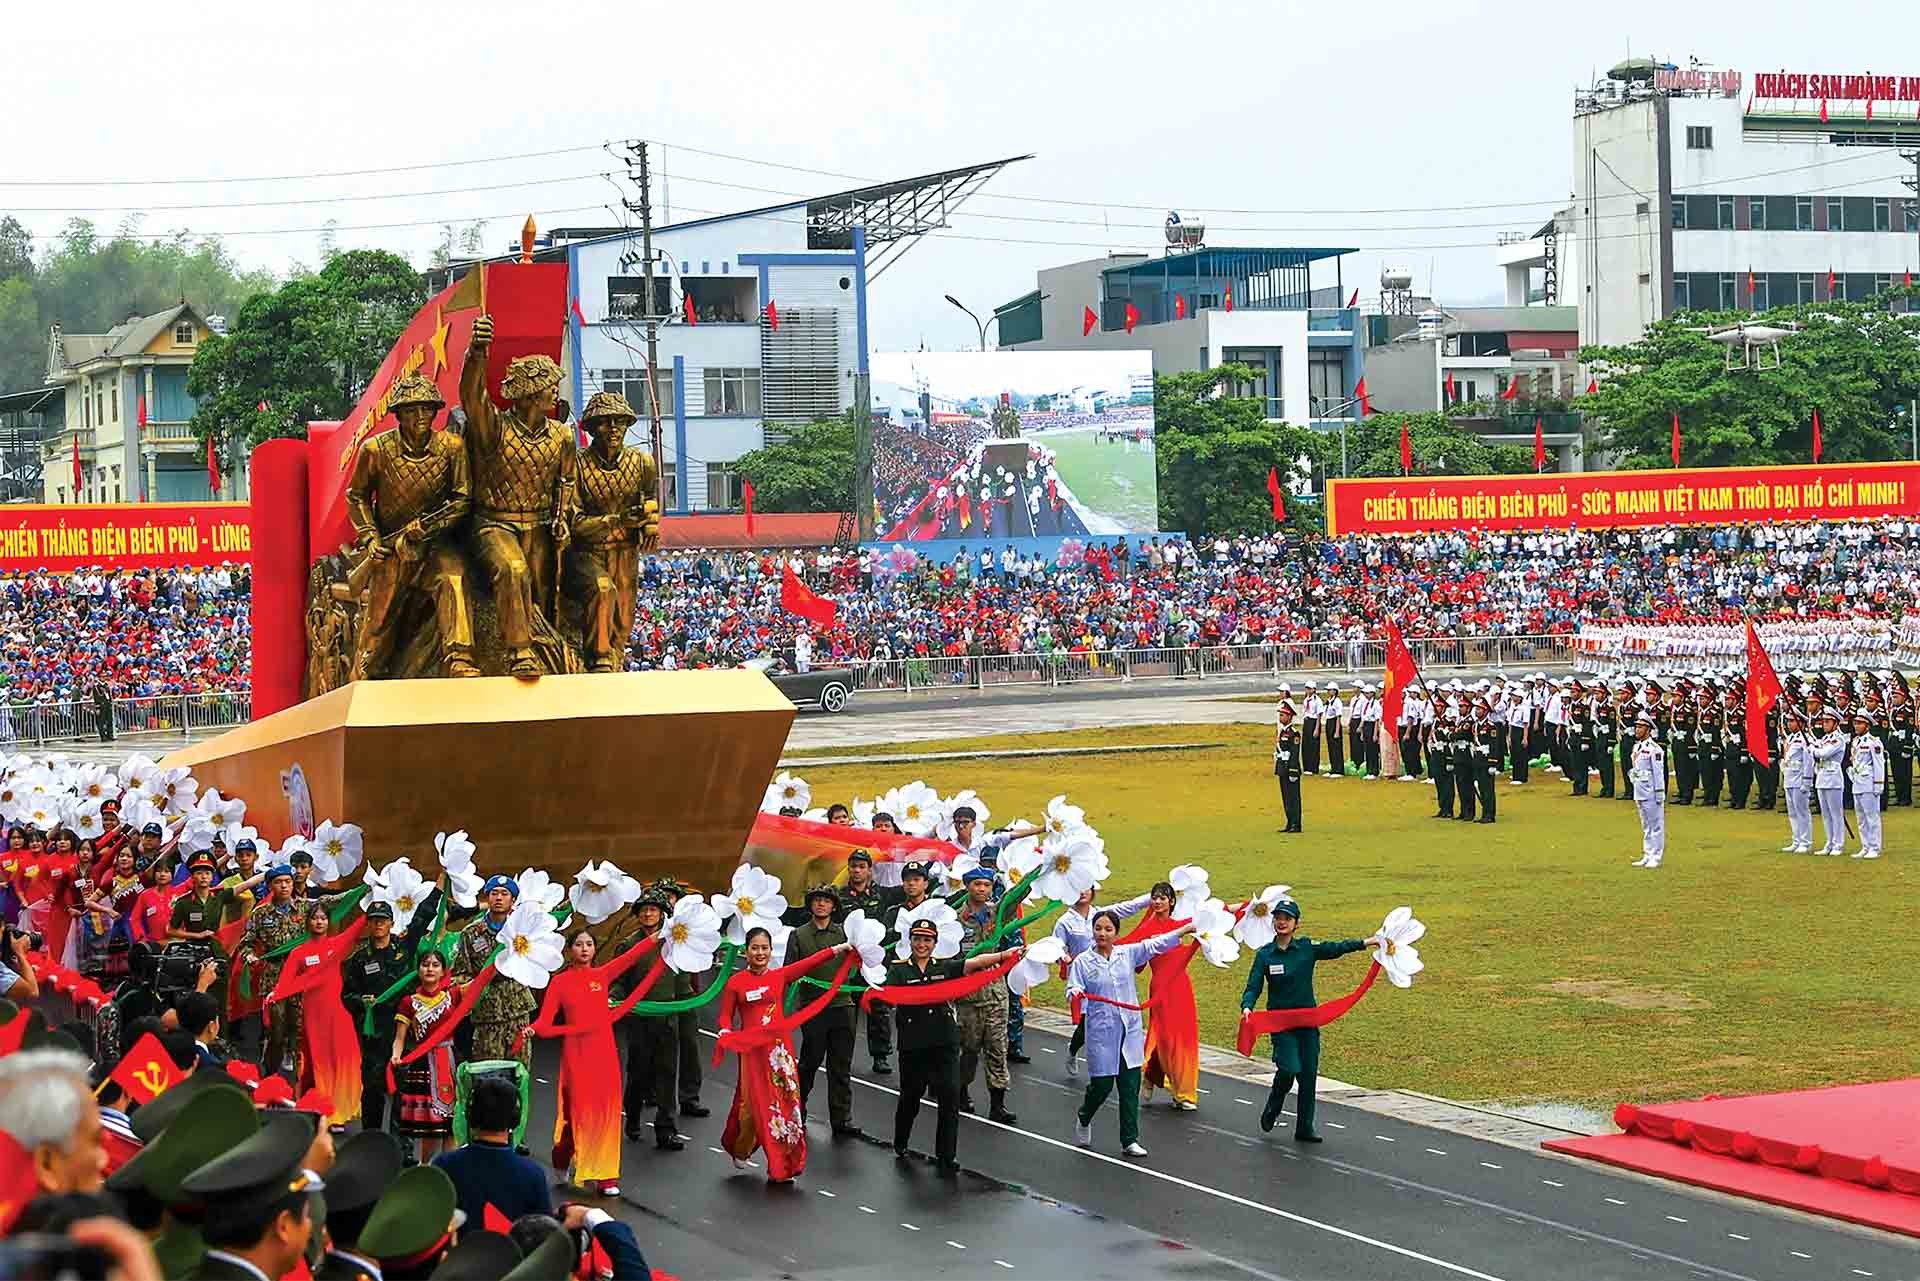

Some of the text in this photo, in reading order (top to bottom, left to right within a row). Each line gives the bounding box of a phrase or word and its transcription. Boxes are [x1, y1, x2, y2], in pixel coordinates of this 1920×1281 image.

[1755, 69, 1807, 98] KHÁCH
[1845, 71, 1896, 101] HOÀNG
[1363, 489, 1407, 521] CHIẾN
[1410, 488, 1458, 520] THẮNG
[1461, 491, 1496, 523] ĐIỆN
[1500, 490, 1535, 518] BIÊN
[1538, 486, 1568, 517] PHỦ
[1581, 488, 1612, 516] SỨC
[1615, 489, 1660, 519] MẠNH
[1663, 484, 1695, 516] VIỆT
[1698, 487, 1733, 511] NAM
[1737, 480, 1770, 510] THỜI
[1774, 484, 1799, 513] ĐẠI
[1804, 476, 1824, 508] HỒ
[1828, 478, 1853, 507] CHÍ
[41, 518, 88, 557] THẮNG
[92, 521, 127, 561] ĐIỆN
[130, 521, 164, 555] BIÊN
[168, 516, 198, 553] PHỦ
[212, 520, 251, 552] LỪNG
